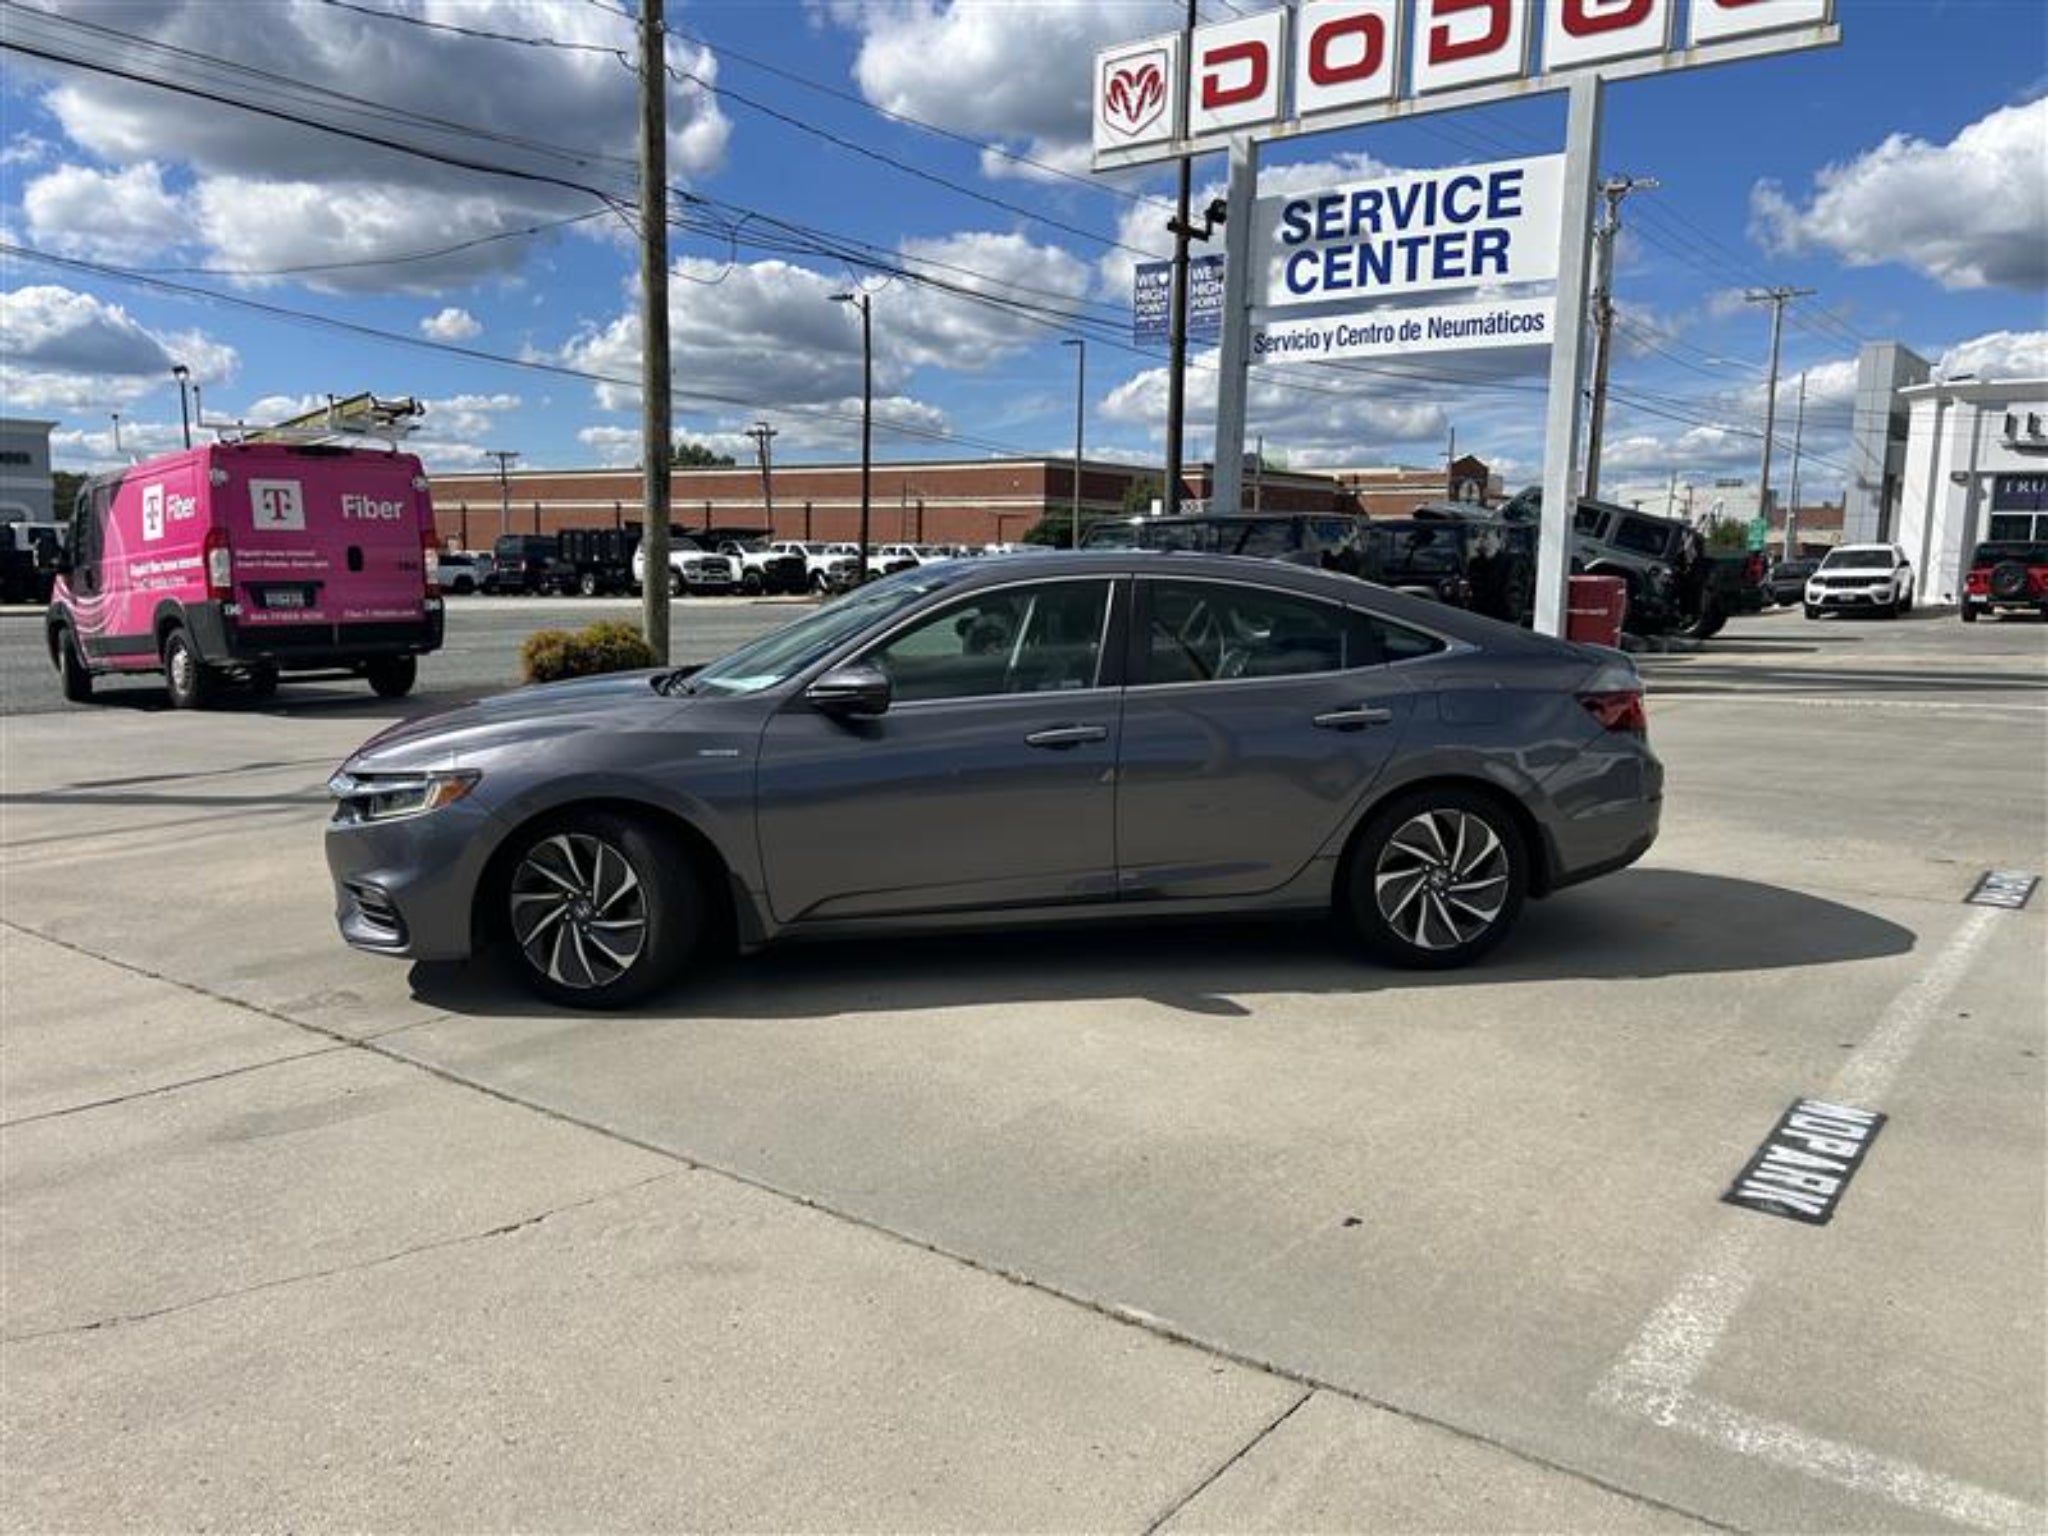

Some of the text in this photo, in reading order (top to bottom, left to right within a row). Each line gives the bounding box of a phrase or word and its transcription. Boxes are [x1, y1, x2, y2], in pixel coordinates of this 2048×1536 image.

[1202, 0, 1762, 109] DOD
[1281, 168, 1524, 247] SERVICE
[1192, 266, 1212, 281] WE
[1286, 227, 1511, 295] CENTER
[1136, 287, 1169, 303] HIGH
[1253, 311, 1545, 354] Servicio y Centro de Neumáticos
[166, 493, 196, 522] Fiber
[340, 493, 404, 519] Fiber
